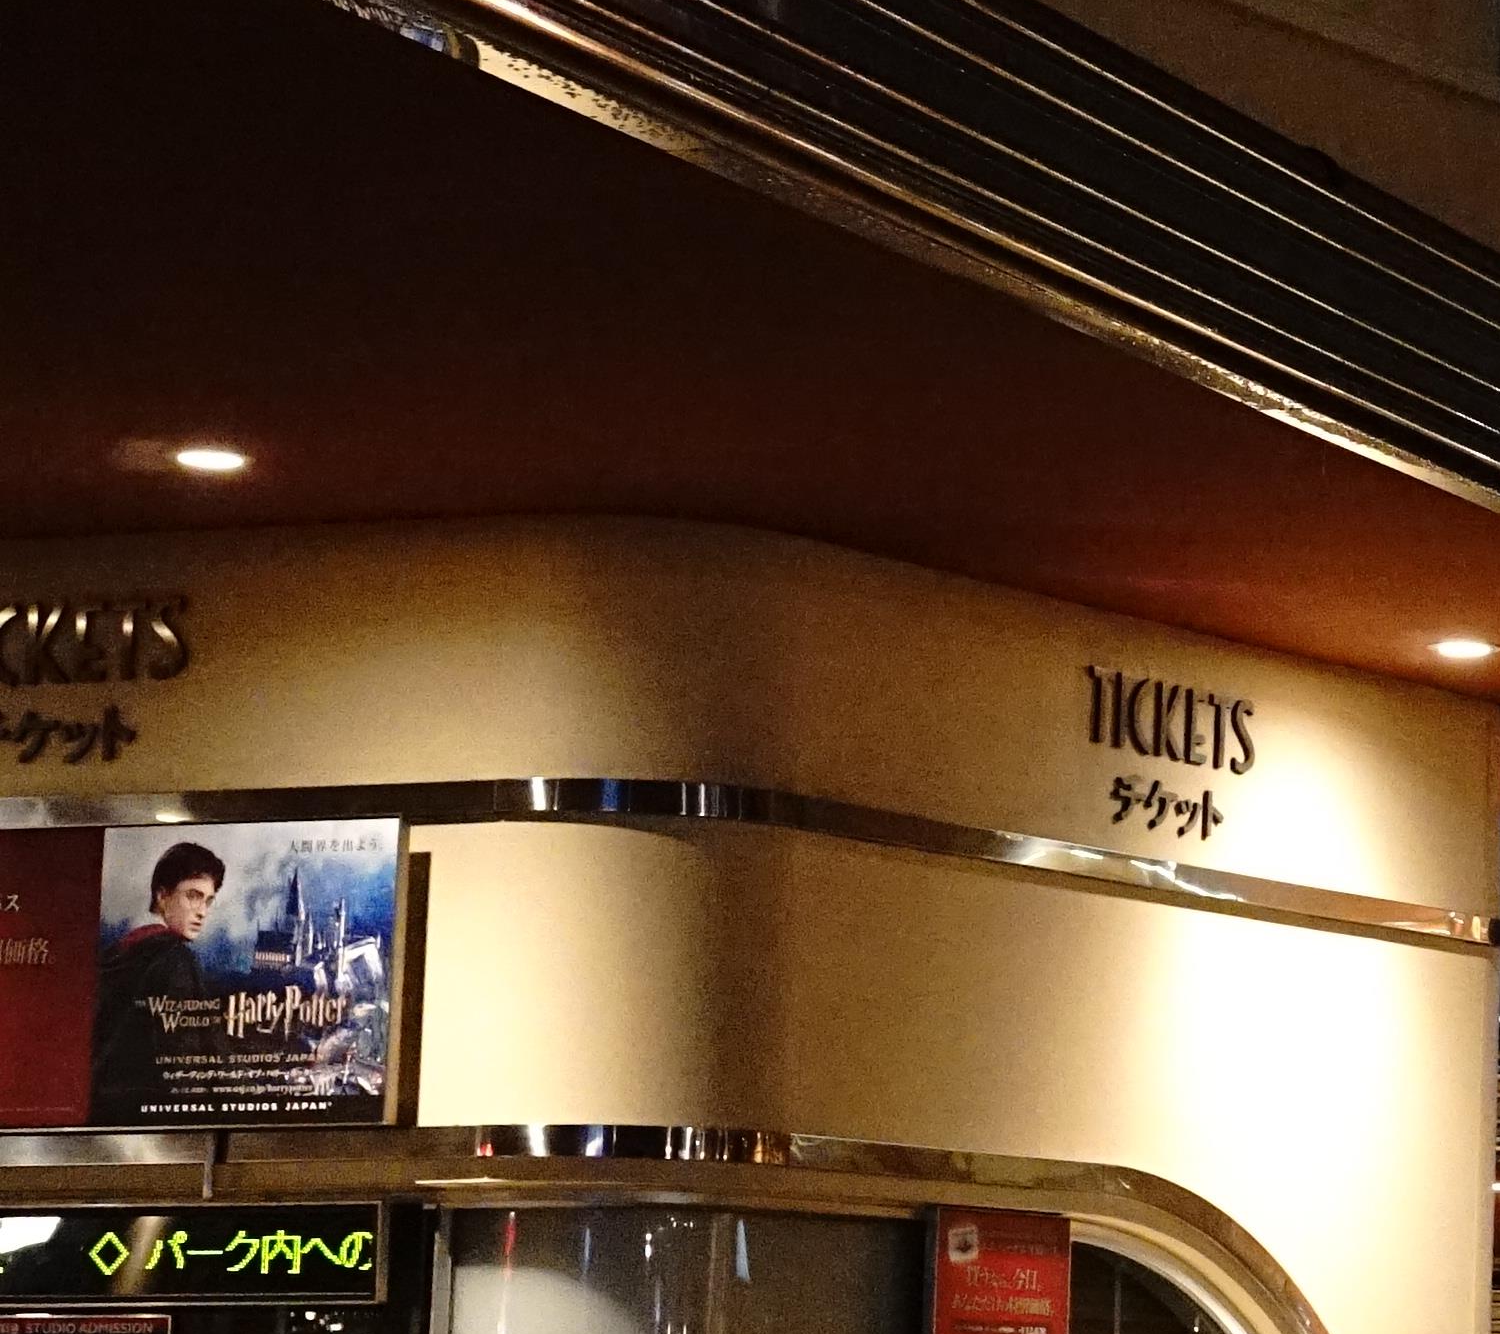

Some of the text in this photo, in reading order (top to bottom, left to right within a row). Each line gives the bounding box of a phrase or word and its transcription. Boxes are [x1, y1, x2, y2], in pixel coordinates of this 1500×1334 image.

[1087, 664, 1255, 775] TICKETS
[1109, 775, 1224, 840] チケット
[148, 995, 220, 1016] WIZARDING
[224, 985, 347, 1041] Harry Potter
[156, 1055, 223, 1064] UNIVERSAL
[228, 1054, 280, 1063] STUDIOS
[141, 1104, 214, 1113] UNIVERSAL
[221, 1103, 278, 1111] STUDIOS
[25, 1322, 76, 1334] STUDIO
[78, 1322, 153, 1334] ADMISSION
